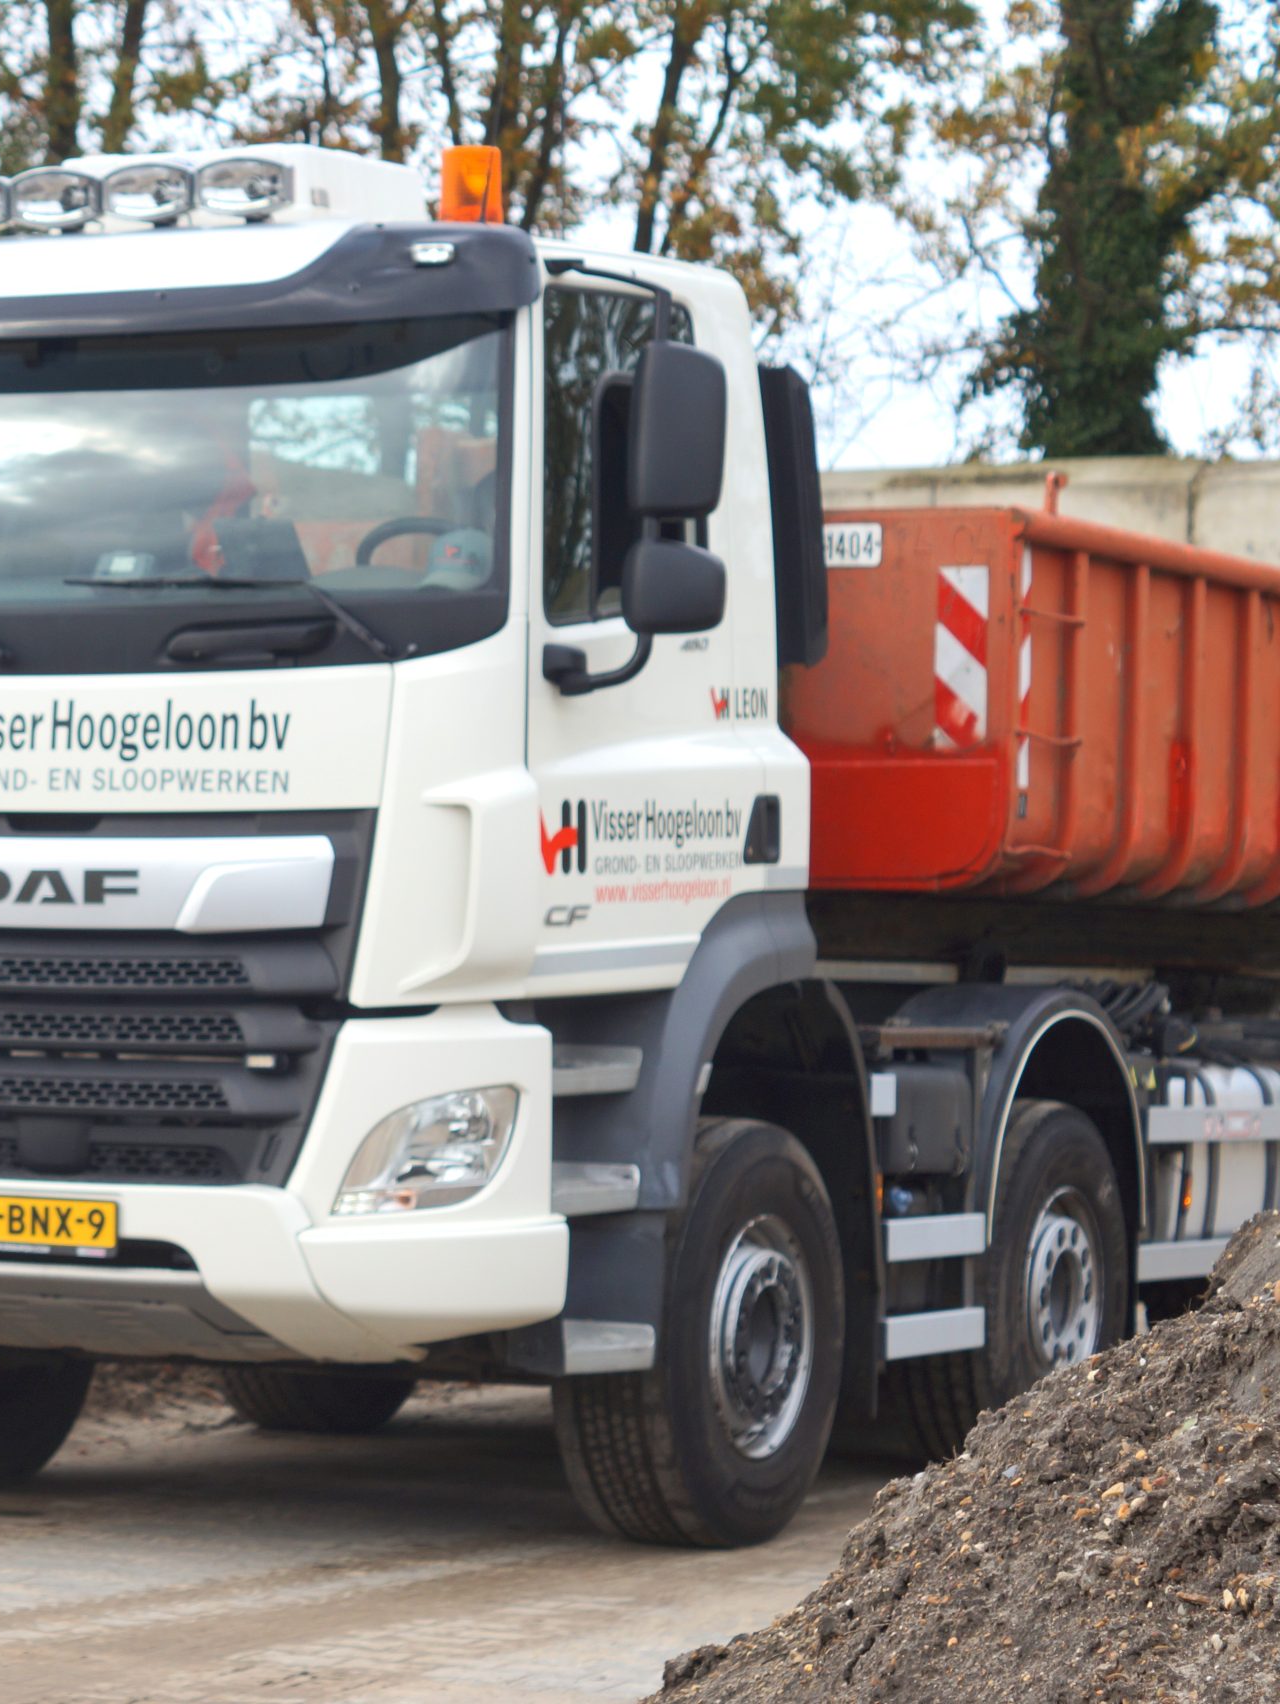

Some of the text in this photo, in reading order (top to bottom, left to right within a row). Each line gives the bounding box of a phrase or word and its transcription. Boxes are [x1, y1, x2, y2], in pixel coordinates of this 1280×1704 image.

[735, 687, 768, 719] LEON
[51, 699, 239, 763] Hoogeloon
[249, 698, 291, 751] bv
[48, 768, 81, 793] EN
[92, 768, 290, 795] SLOOPWERKEN
[592, 799, 742, 849] Visser Hoogeloon bv
[595, 850, 743, 876] GROND- EN SLOOPWERKEN
[544, 905, 591, 927] CF
